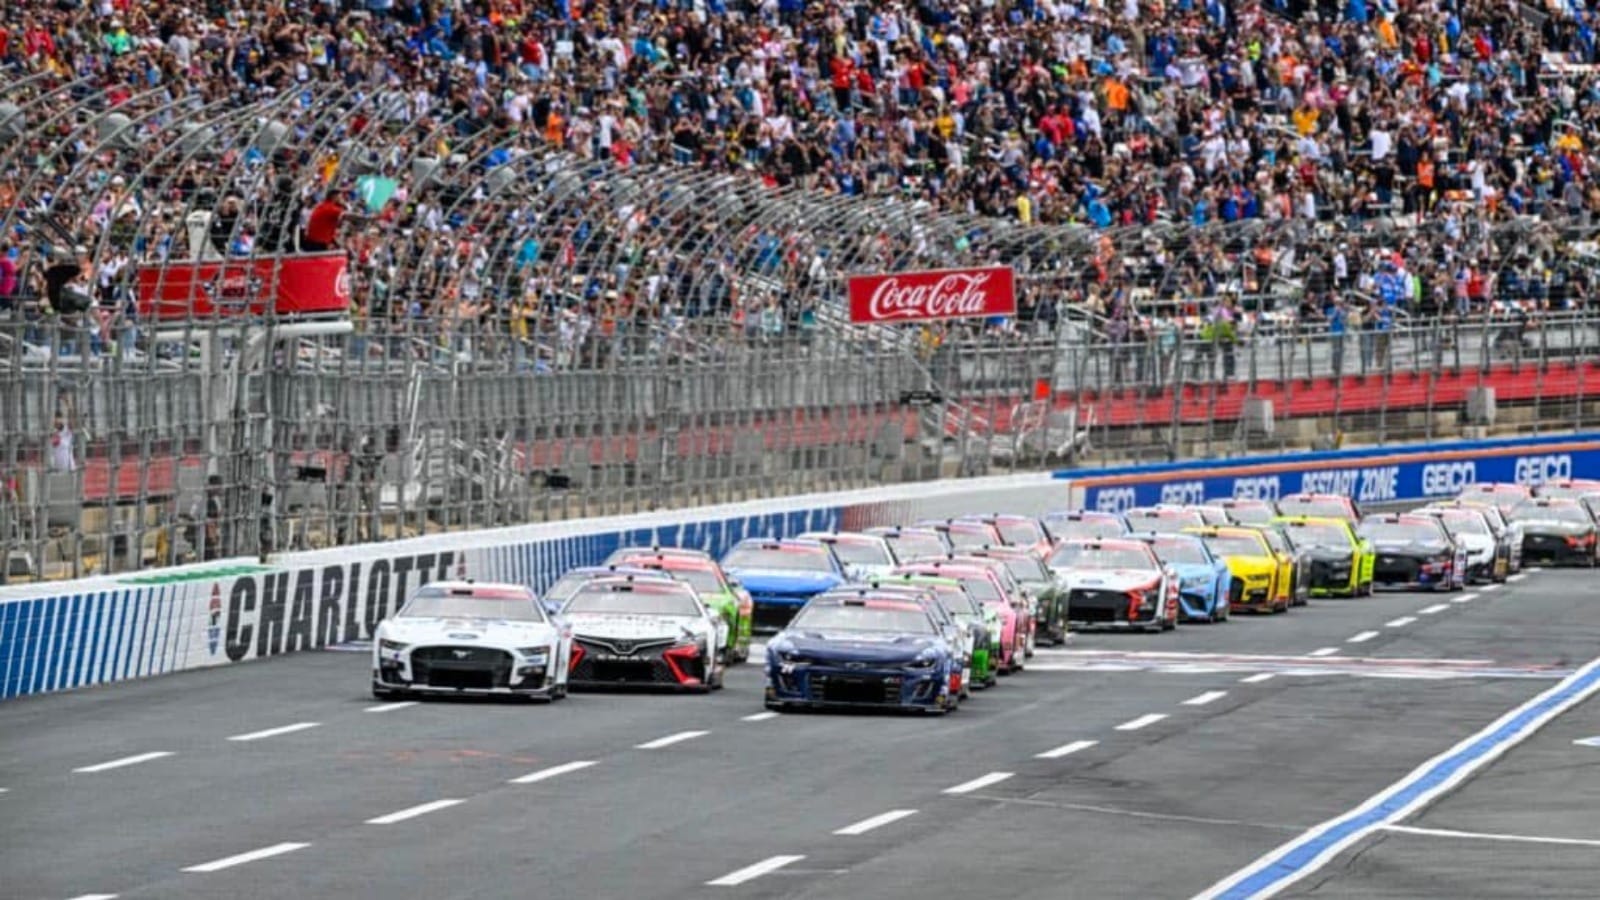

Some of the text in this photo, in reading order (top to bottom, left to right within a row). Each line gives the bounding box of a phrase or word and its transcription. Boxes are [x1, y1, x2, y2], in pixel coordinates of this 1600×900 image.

[869, 272, 991, 319] Coca-Cola
[1301, 466, 1398, 500] RESTART ZONE
[1422, 461, 1476, 494] GEICO
[1515, 455, 1570, 485] GEICO
[1233, 476, 1279, 500] GEICO
